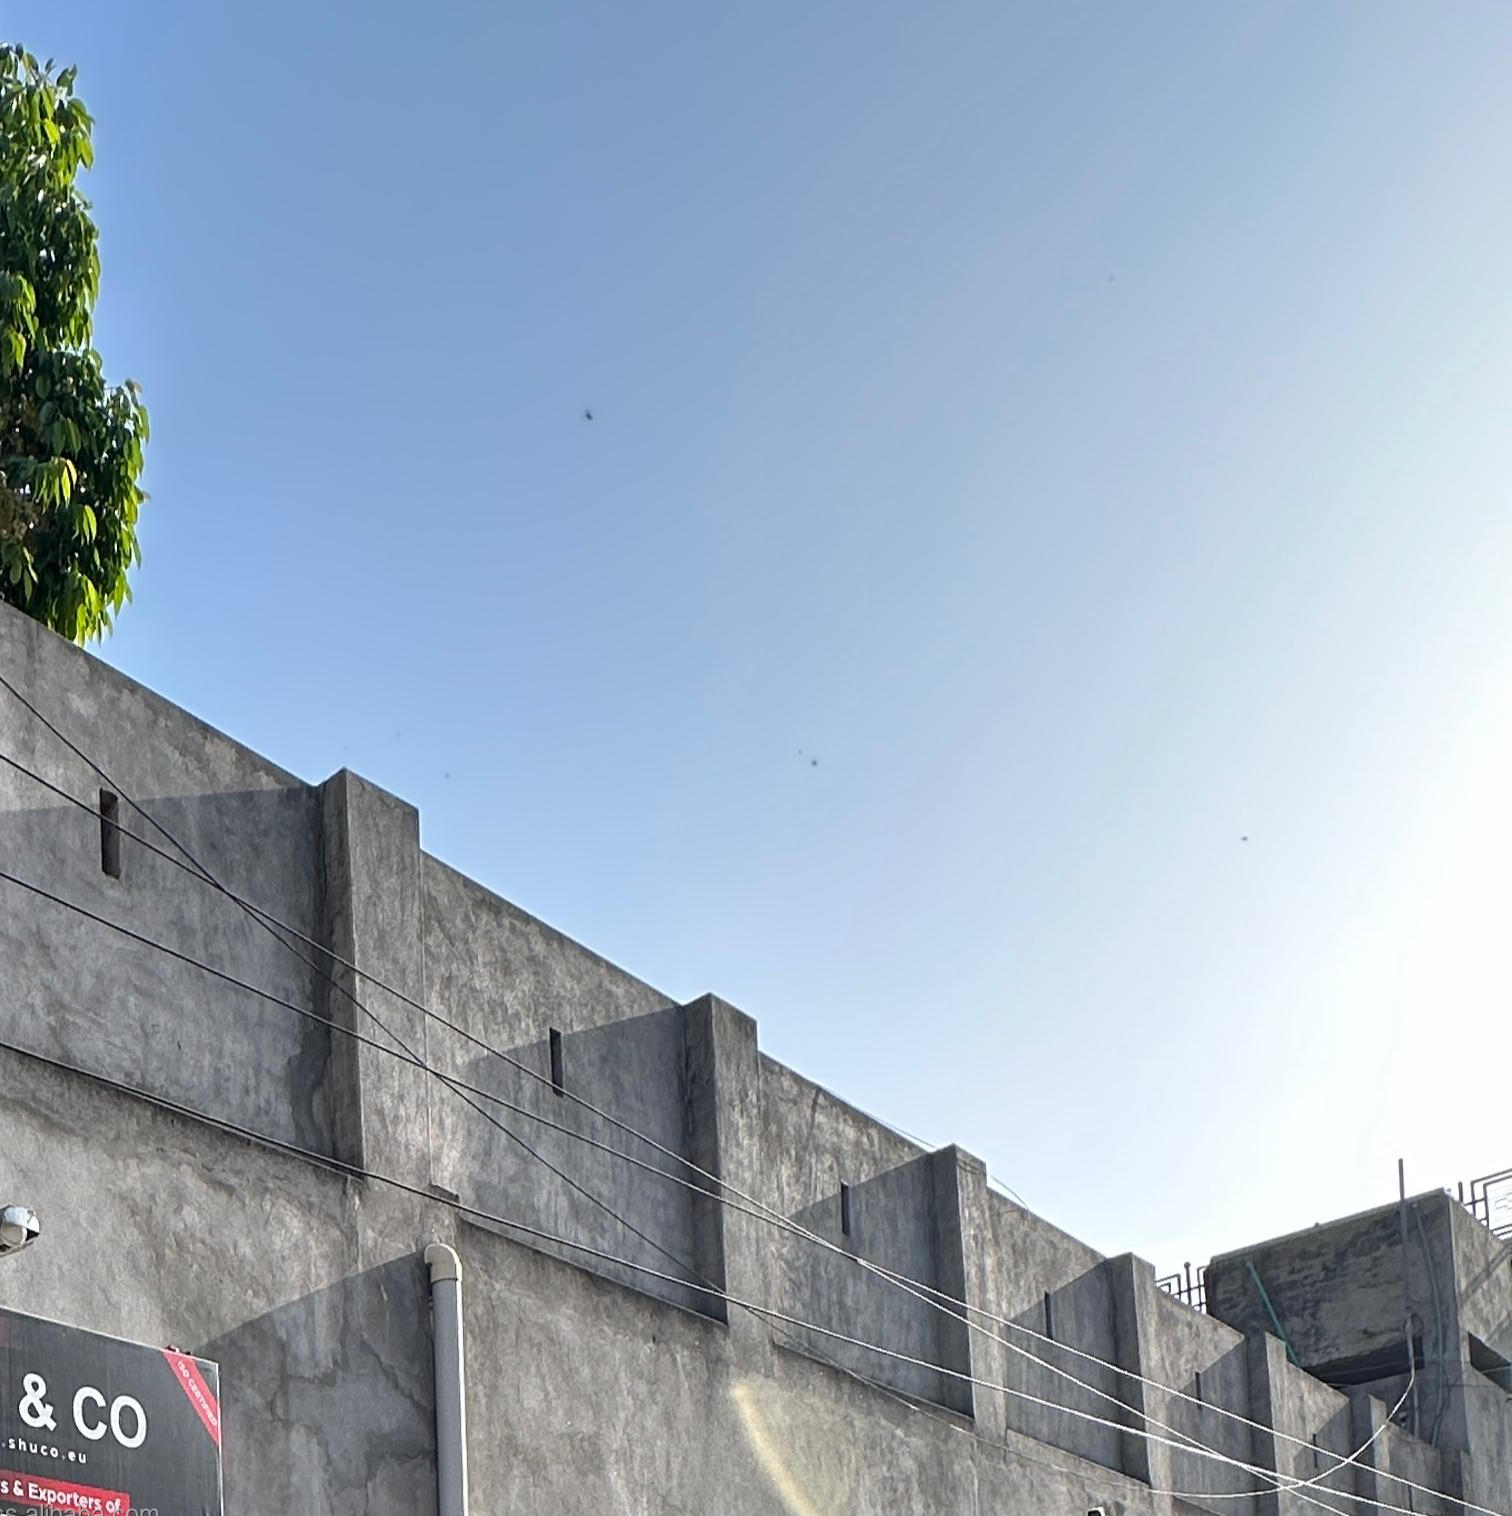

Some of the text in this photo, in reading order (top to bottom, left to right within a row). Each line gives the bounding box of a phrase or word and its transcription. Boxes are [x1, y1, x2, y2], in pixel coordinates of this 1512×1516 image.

[18, 1373, 57, 1431] &
[73, 1386, 147, 1449] CO
[12, 1483, 25, 1497] &
[28, 1483, 102, 1512] Exporters
